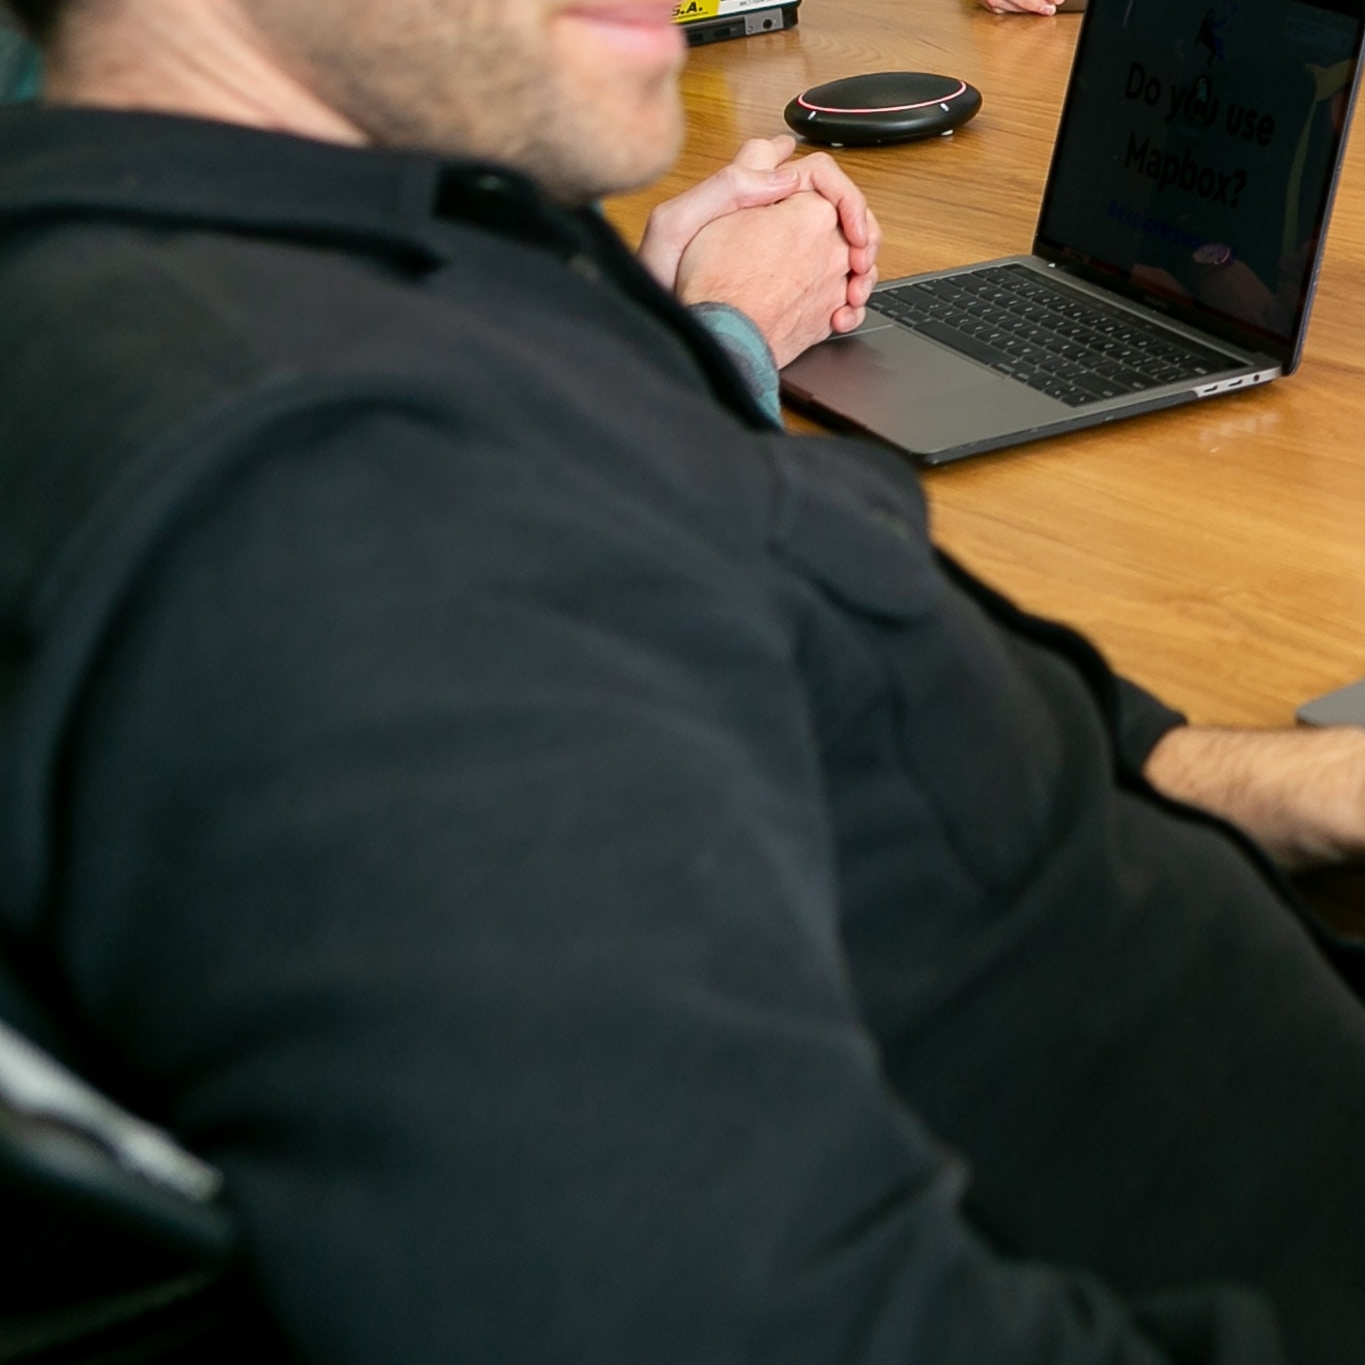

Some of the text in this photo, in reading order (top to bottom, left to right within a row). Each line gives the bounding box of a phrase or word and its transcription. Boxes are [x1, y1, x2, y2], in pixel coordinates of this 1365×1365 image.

[1125, 62, 1276, 147] Do you use
[1123, 132, 1249, 210] Mapbox?
